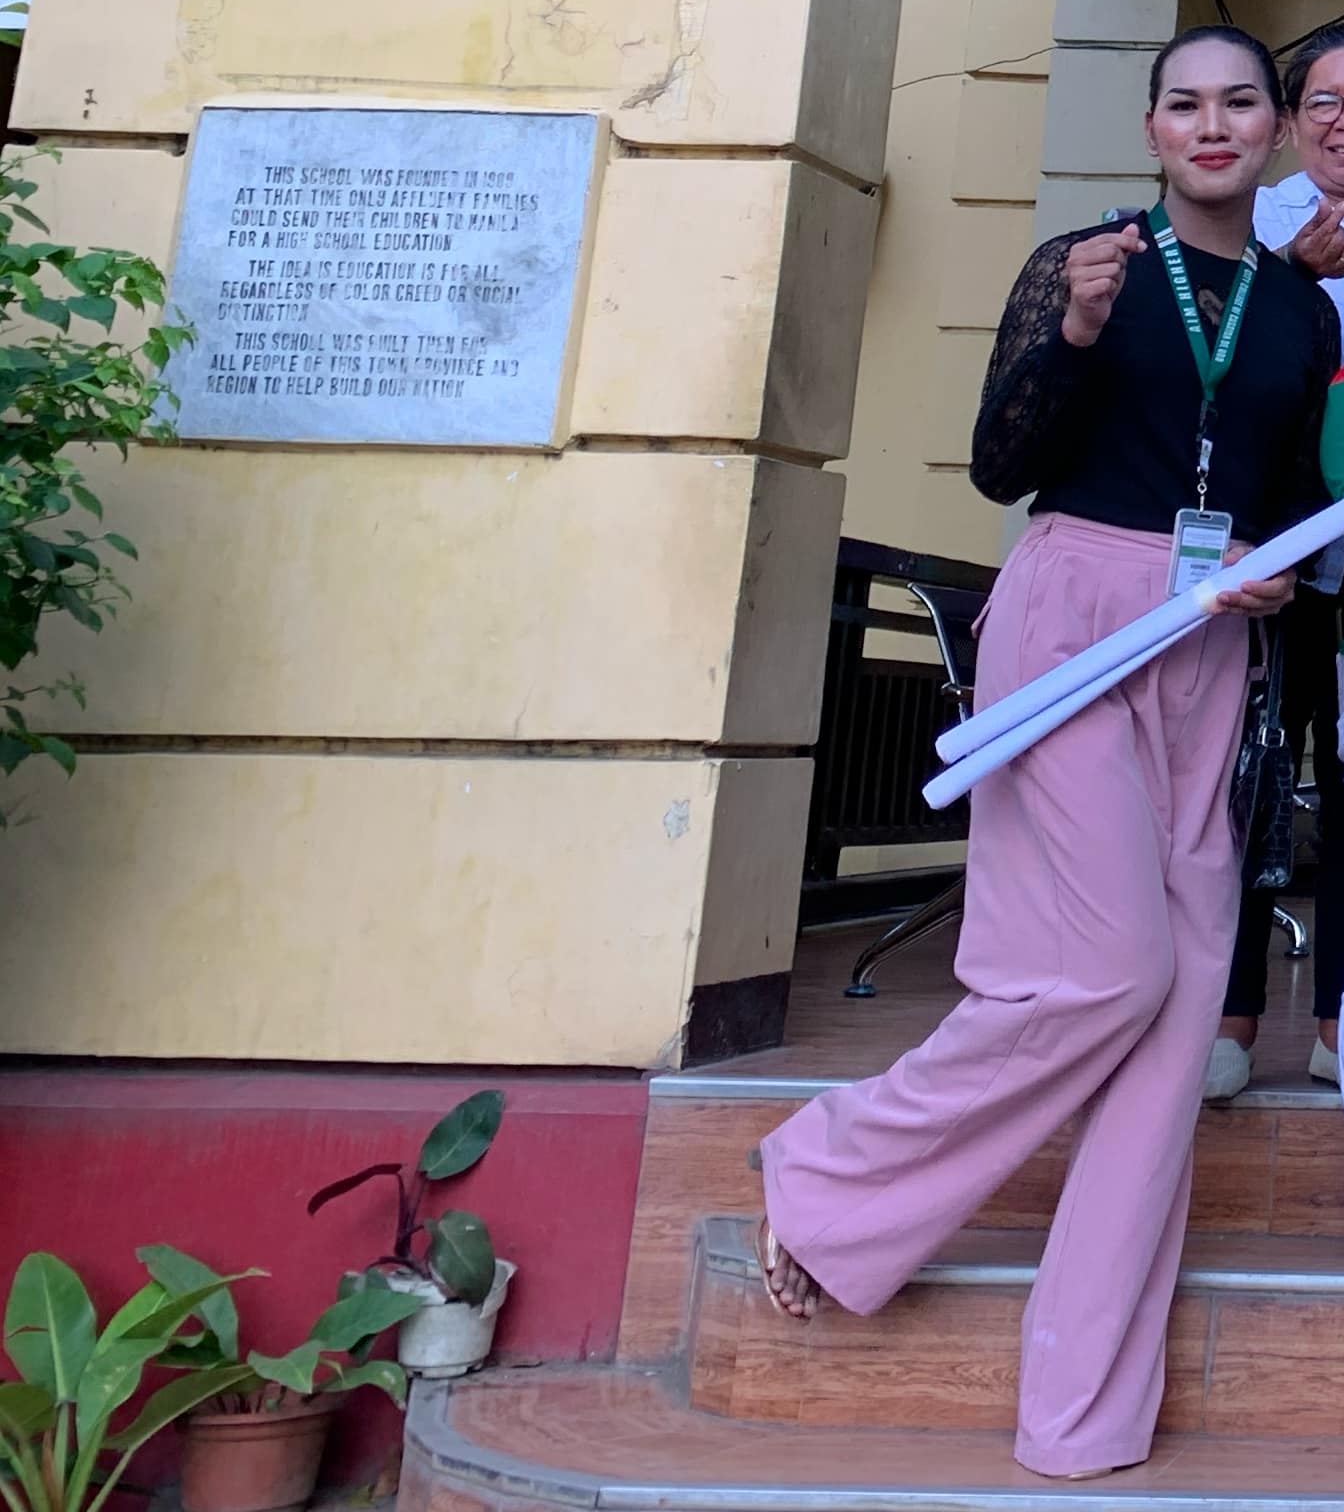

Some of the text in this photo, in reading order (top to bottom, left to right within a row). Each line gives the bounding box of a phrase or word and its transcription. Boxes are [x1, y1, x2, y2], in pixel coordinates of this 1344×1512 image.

[265, 166, 394, 186] THIS SCHOOL WAS
[235, 188, 539, 211] AT THAT TIME ONLY AFFLUENT FAMILIES
[231, 209, 463, 230] COULD SEND THEIR CHILDREN TO
[228, 230, 452, 251] FOR A HIGH SCHOOL EDUCATION
[249, 260, 275, 278] THE
[280, 260, 311, 278] IDEA
[318, 261, 332, 279] IS
[337, 261, 416, 279] EDUCATION
[421, 263, 435, 281] IS
[220, 281, 522, 304] REGARDLESS OF COLOR CREED OR SOCIAL
[1165, 249, 1200, 332] AIM HIGHER
[218, 303, 309, 322] DISTINCTION
[235, 332, 455, 354] THIS WAS THEN
[210, 354, 361, 373] ALL PEOPLE OF THIS
[206, 375, 464, 398] REGION TO HELP BUILD OUR NATION
